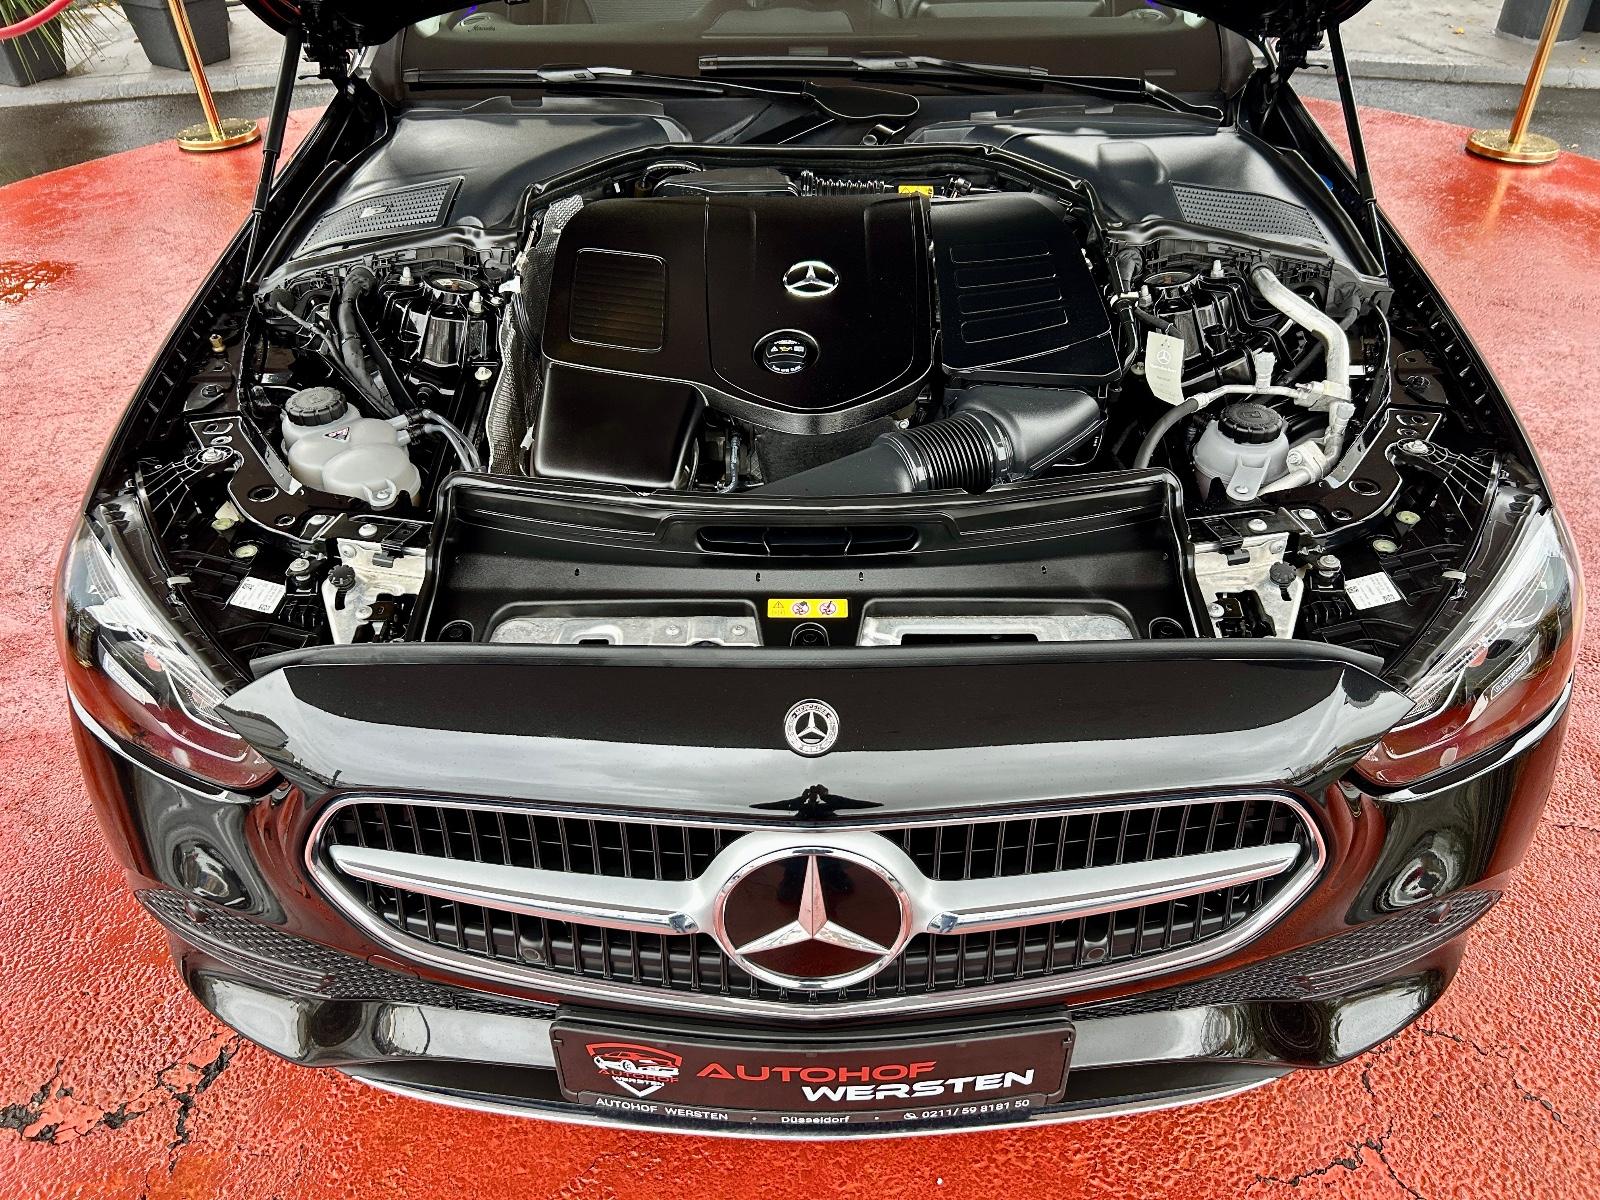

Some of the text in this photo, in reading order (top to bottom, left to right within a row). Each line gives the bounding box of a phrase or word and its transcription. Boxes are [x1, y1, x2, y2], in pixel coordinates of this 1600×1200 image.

[697, 1061, 937, 1083] AUTOHOF
[802, 1068, 1035, 1102] WERSTEN
[595, 1097, 658, 1114] AUTOHOF
[664, 1106, 729, 1121] WERSTEN
[781, 1115, 851, 1124] Düsseldorf
[961, 1106, 977, 1115] 59
[1014, 1099, 1030, 1108] 50
